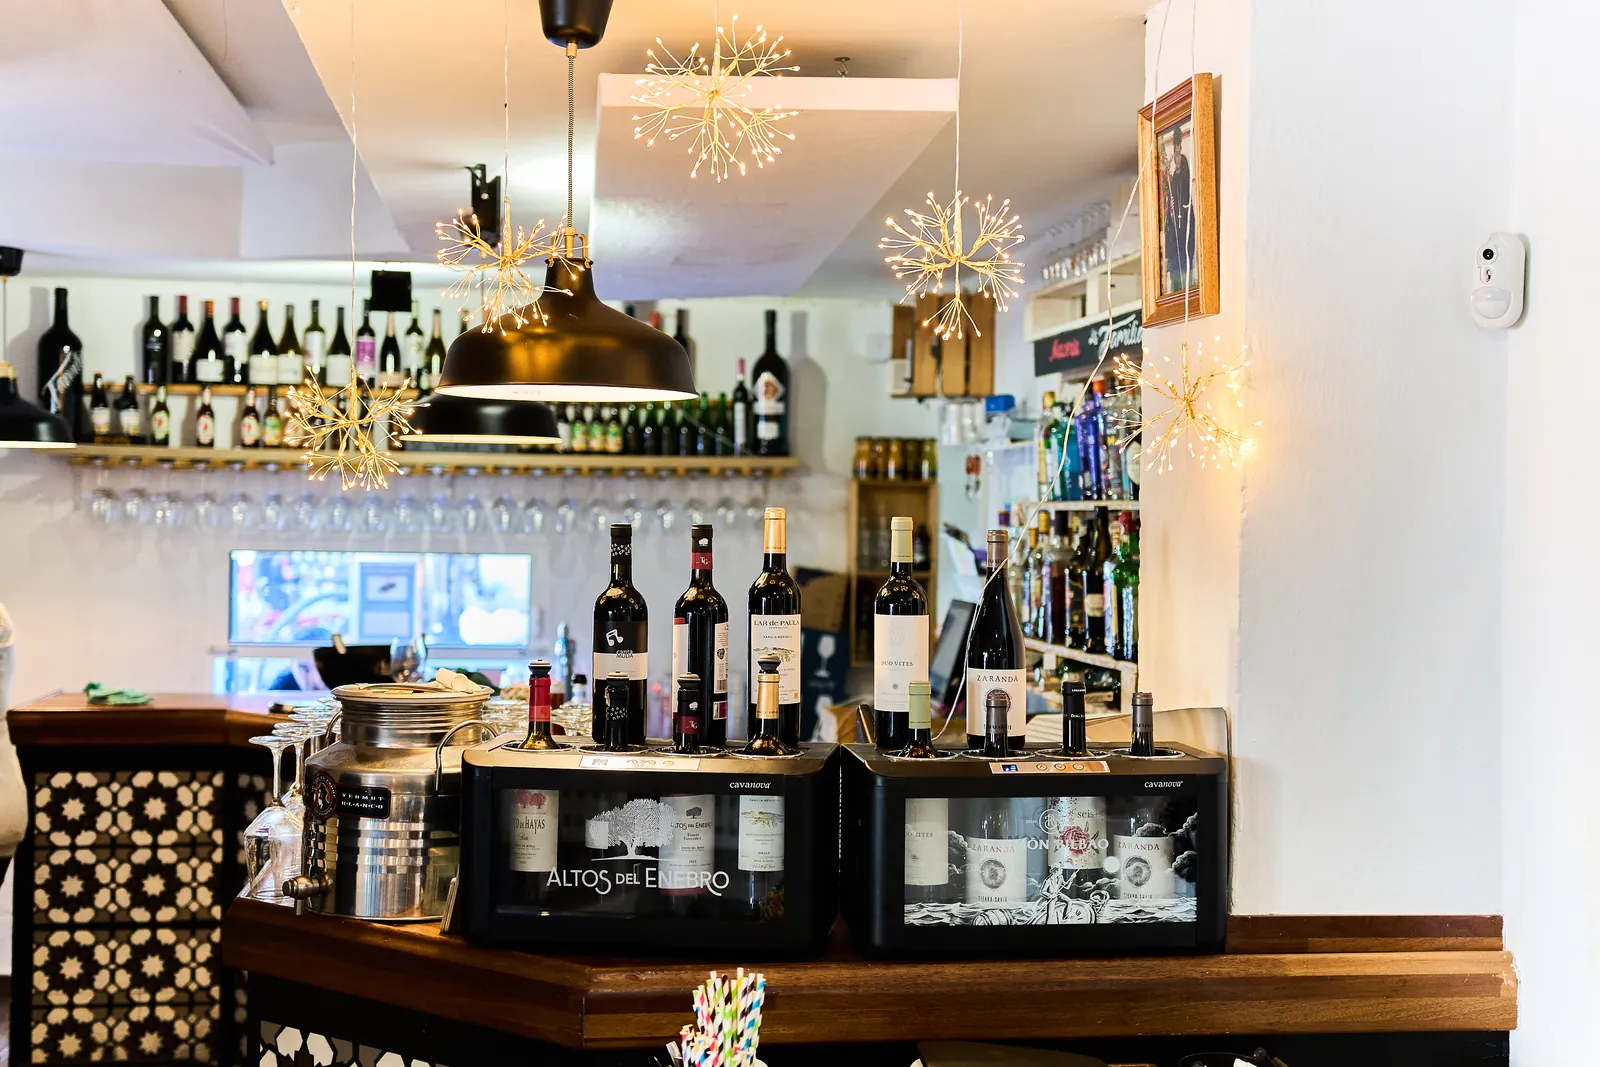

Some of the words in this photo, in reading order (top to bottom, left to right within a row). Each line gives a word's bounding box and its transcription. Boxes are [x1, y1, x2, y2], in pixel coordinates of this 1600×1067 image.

[976, 674, 1019, 683] ZARANDA
[729, 781, 772, 789] cavanova
[1144, 780, 1183, 788] cavanova
[525, 816, 545, 834] HAYAS
[971, 843, 1015, 853] ZARANDA
[1117, 841, 1160, 851] ZARANDA
[546, 867, 612, 895] ALTOS
[615, 873, 641, 885] DEL
[645, 867, 730, 896] ENEBRO
